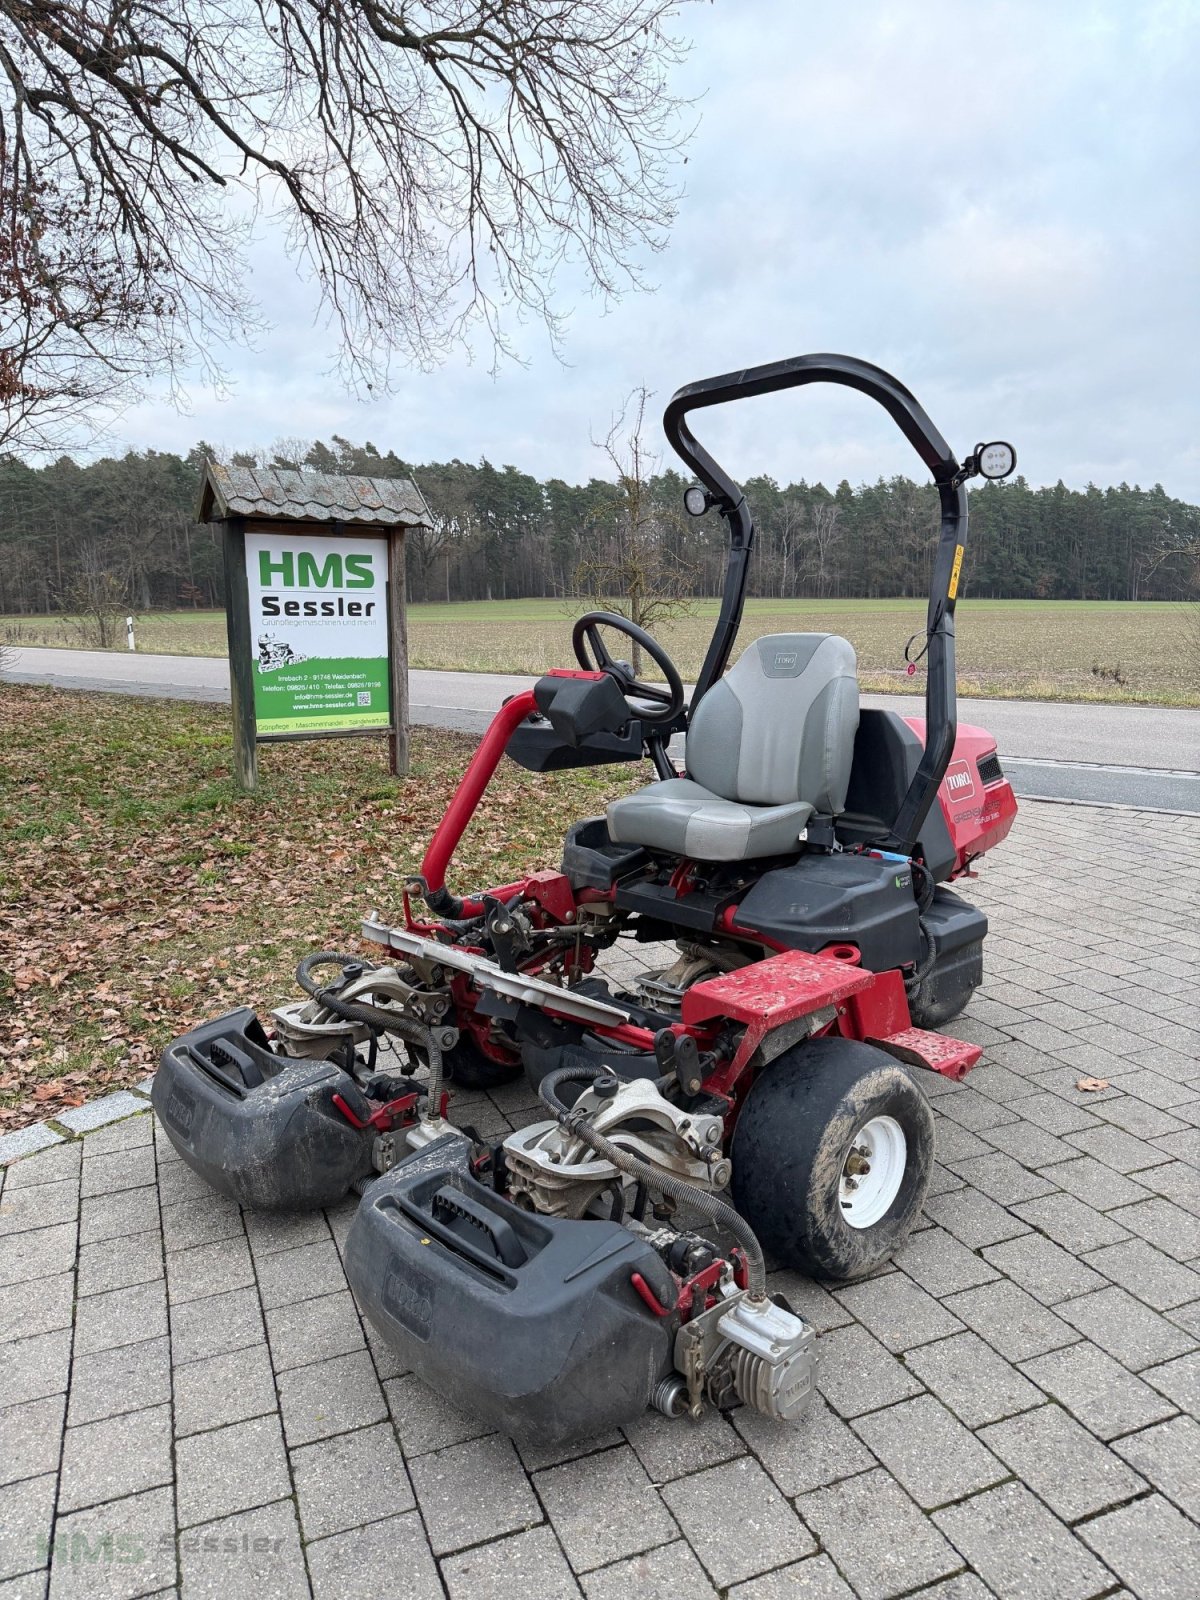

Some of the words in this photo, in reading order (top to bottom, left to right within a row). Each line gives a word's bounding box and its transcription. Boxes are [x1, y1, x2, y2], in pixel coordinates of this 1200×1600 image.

[259, 550, 375, 588] HMS
[262, 596, 376, 617] Sessler
[262, 618, 342, 628] Grünpflegemaschinen
[343, 618, 356, 627] und
[777, 656, 795, 664] TORO
[332, 672, 367, 680] Weidenbach
[262, 684, 286, 692] Telefon:
[294, 692, 353, 701] info@hms-sessler.de
[292, 701, 356, 710] www.hms-sessler.de
[257, 723, 290, 731] Grünpflege
[295, 719, 343, 729] Maschinenhandel
[946, 771, 971, 791] TORO
[386, 1271, 433, 1323] TORO
[785, 1374, 810, 1398] TORO
